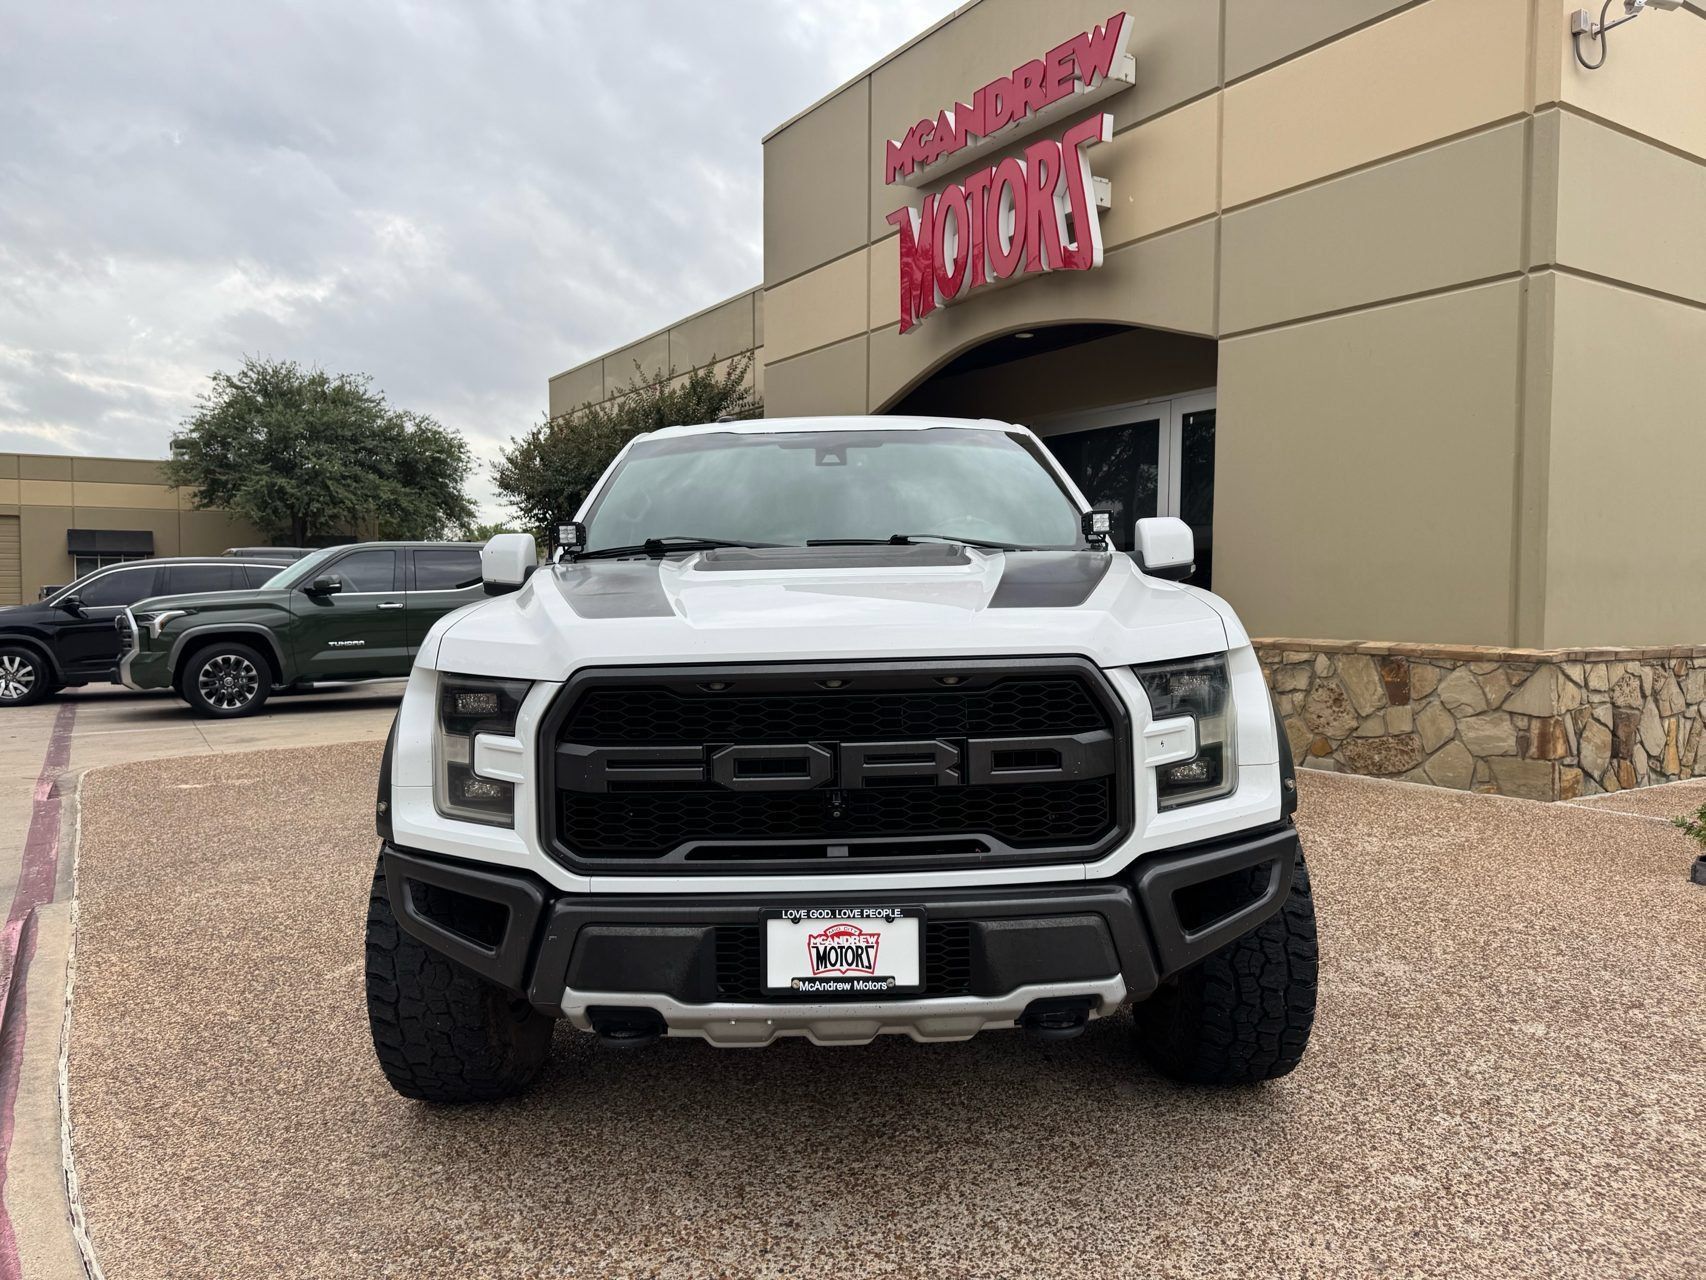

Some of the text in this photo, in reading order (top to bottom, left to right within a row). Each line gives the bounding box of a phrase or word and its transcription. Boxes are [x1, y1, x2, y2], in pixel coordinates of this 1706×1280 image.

[886, 112, 1104, 335] MOTORS
[554, 730, 1116, 792] FORD
[782, 908, 904, 919] LOVE GOD. LOVE PEOPLE.
[811, 945, 875, 972] MOTORS
[800, 980, 888, 992] McAndrew Motors
